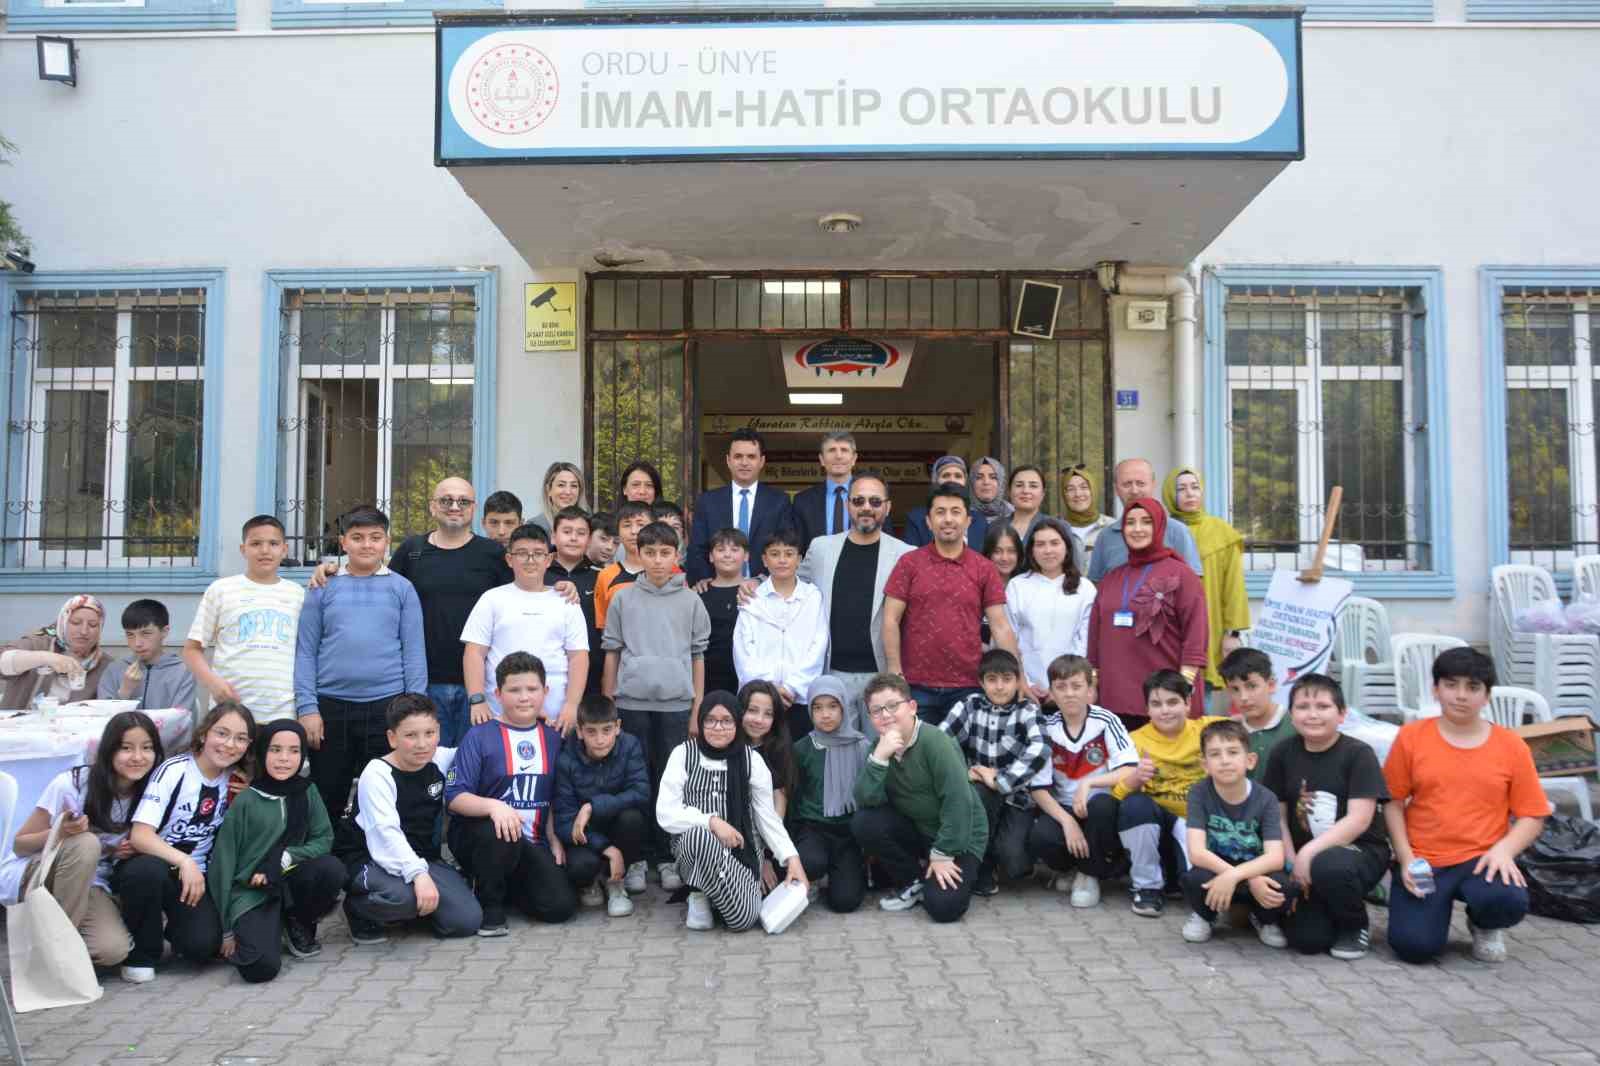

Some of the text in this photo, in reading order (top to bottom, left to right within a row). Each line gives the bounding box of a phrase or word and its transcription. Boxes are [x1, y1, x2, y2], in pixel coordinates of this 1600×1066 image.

[582, 52, 668, 75] ORDU
[699, 47, 777, 75] ÜNYE
[581, 79, 881, 129] İMAM-HATİP
[900, 86, 1221, 125] ORTAOKULU
[239, 608, 291, 641] NYC
